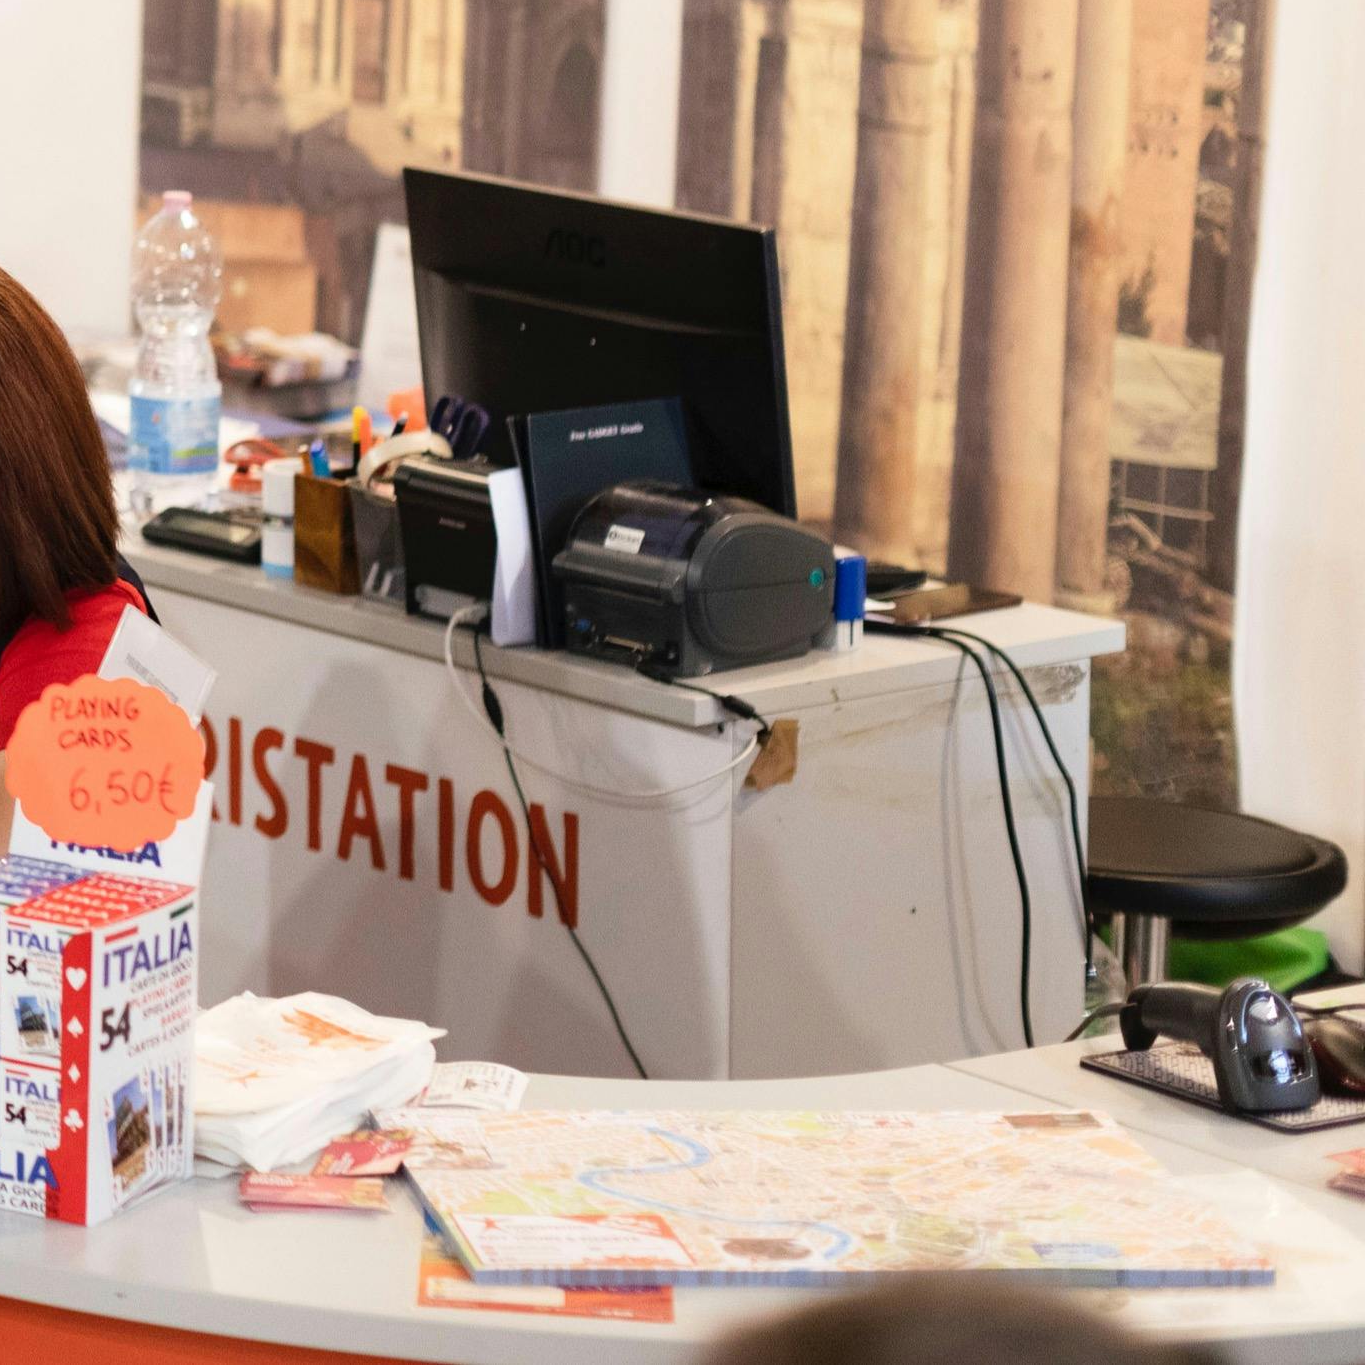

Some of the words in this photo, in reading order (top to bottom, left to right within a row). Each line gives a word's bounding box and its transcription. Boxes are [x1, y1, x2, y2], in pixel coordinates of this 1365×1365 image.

[50, 696, 142, 722] PLAYING
[58, 728, 133, 752] CARDS
[69, 762, 178, 816] 6,50€
[7, 929, 65, 954] ITALI
[7, 954, 29, 977] 54
[103, 920, 192, 989] ITALIA
[99, 1001, 132, 1052] 54
[5, 1102, 27, 1126] 54
